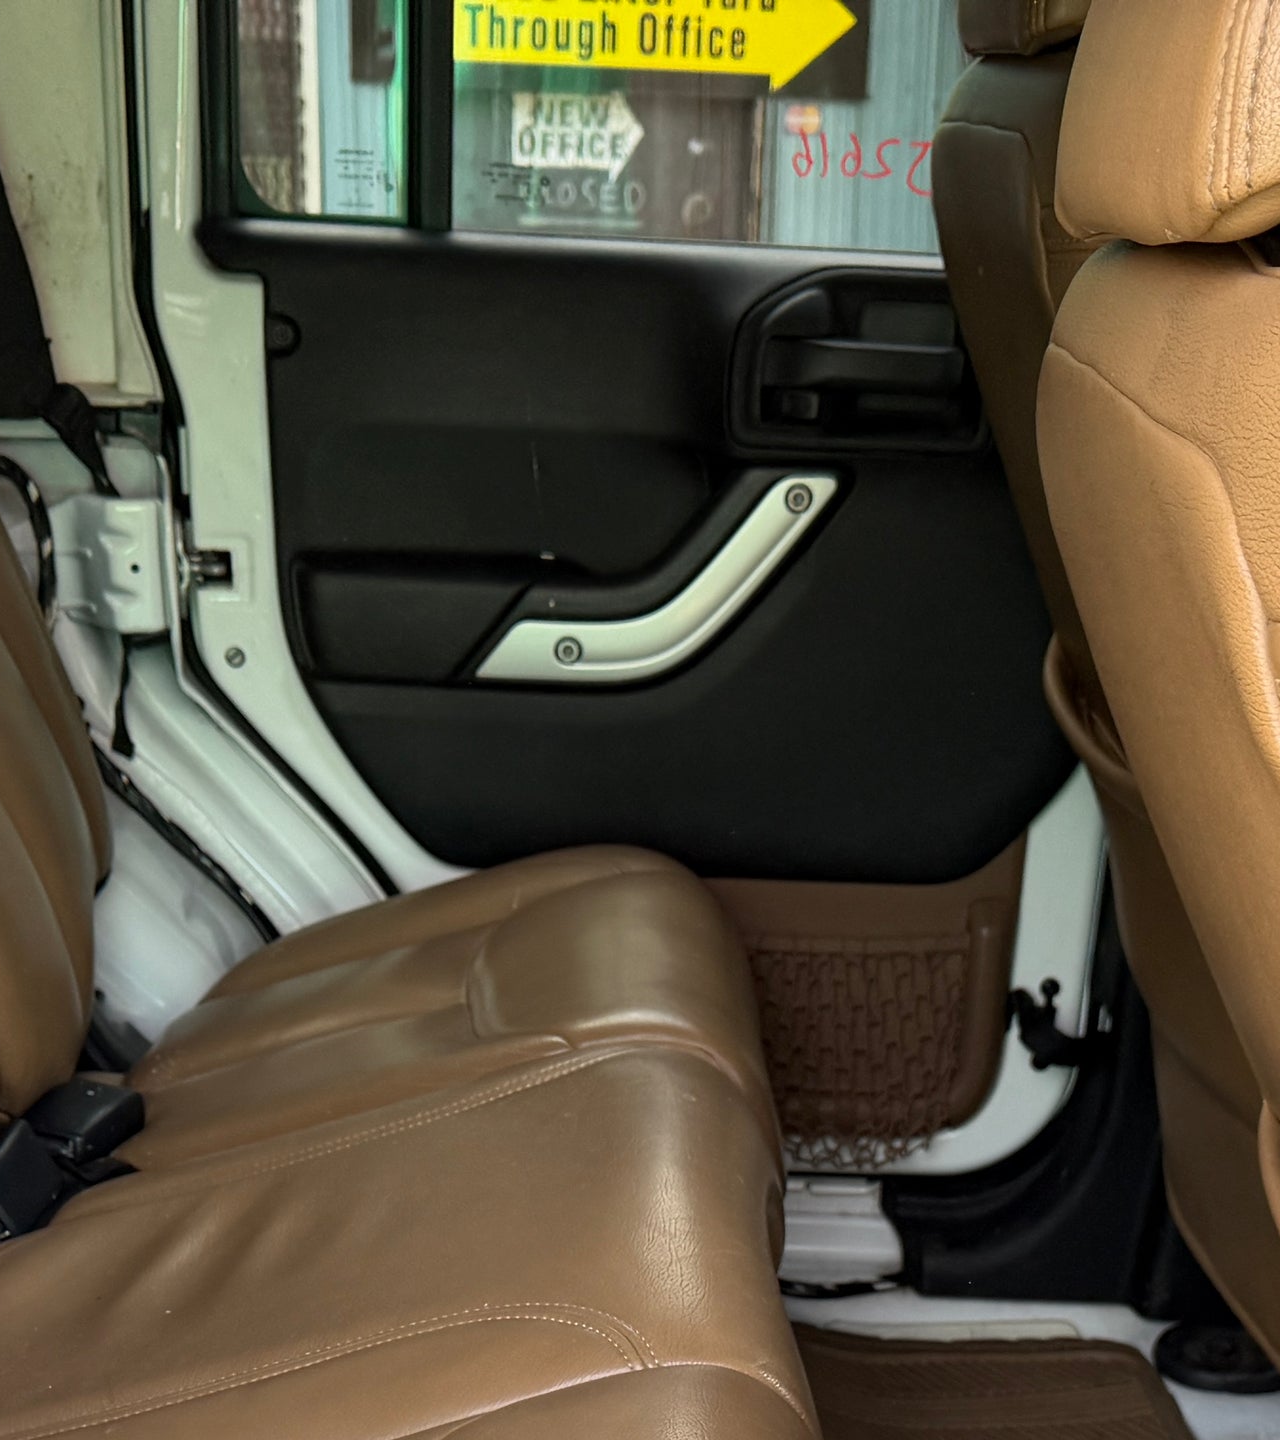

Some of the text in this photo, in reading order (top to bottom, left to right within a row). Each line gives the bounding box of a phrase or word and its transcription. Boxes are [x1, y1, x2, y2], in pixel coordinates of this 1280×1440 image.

[465, 4, 747, 60] Through Office
[533, 99, 609, 127] NEW
[519, 125, 627, 159] OFFICE
